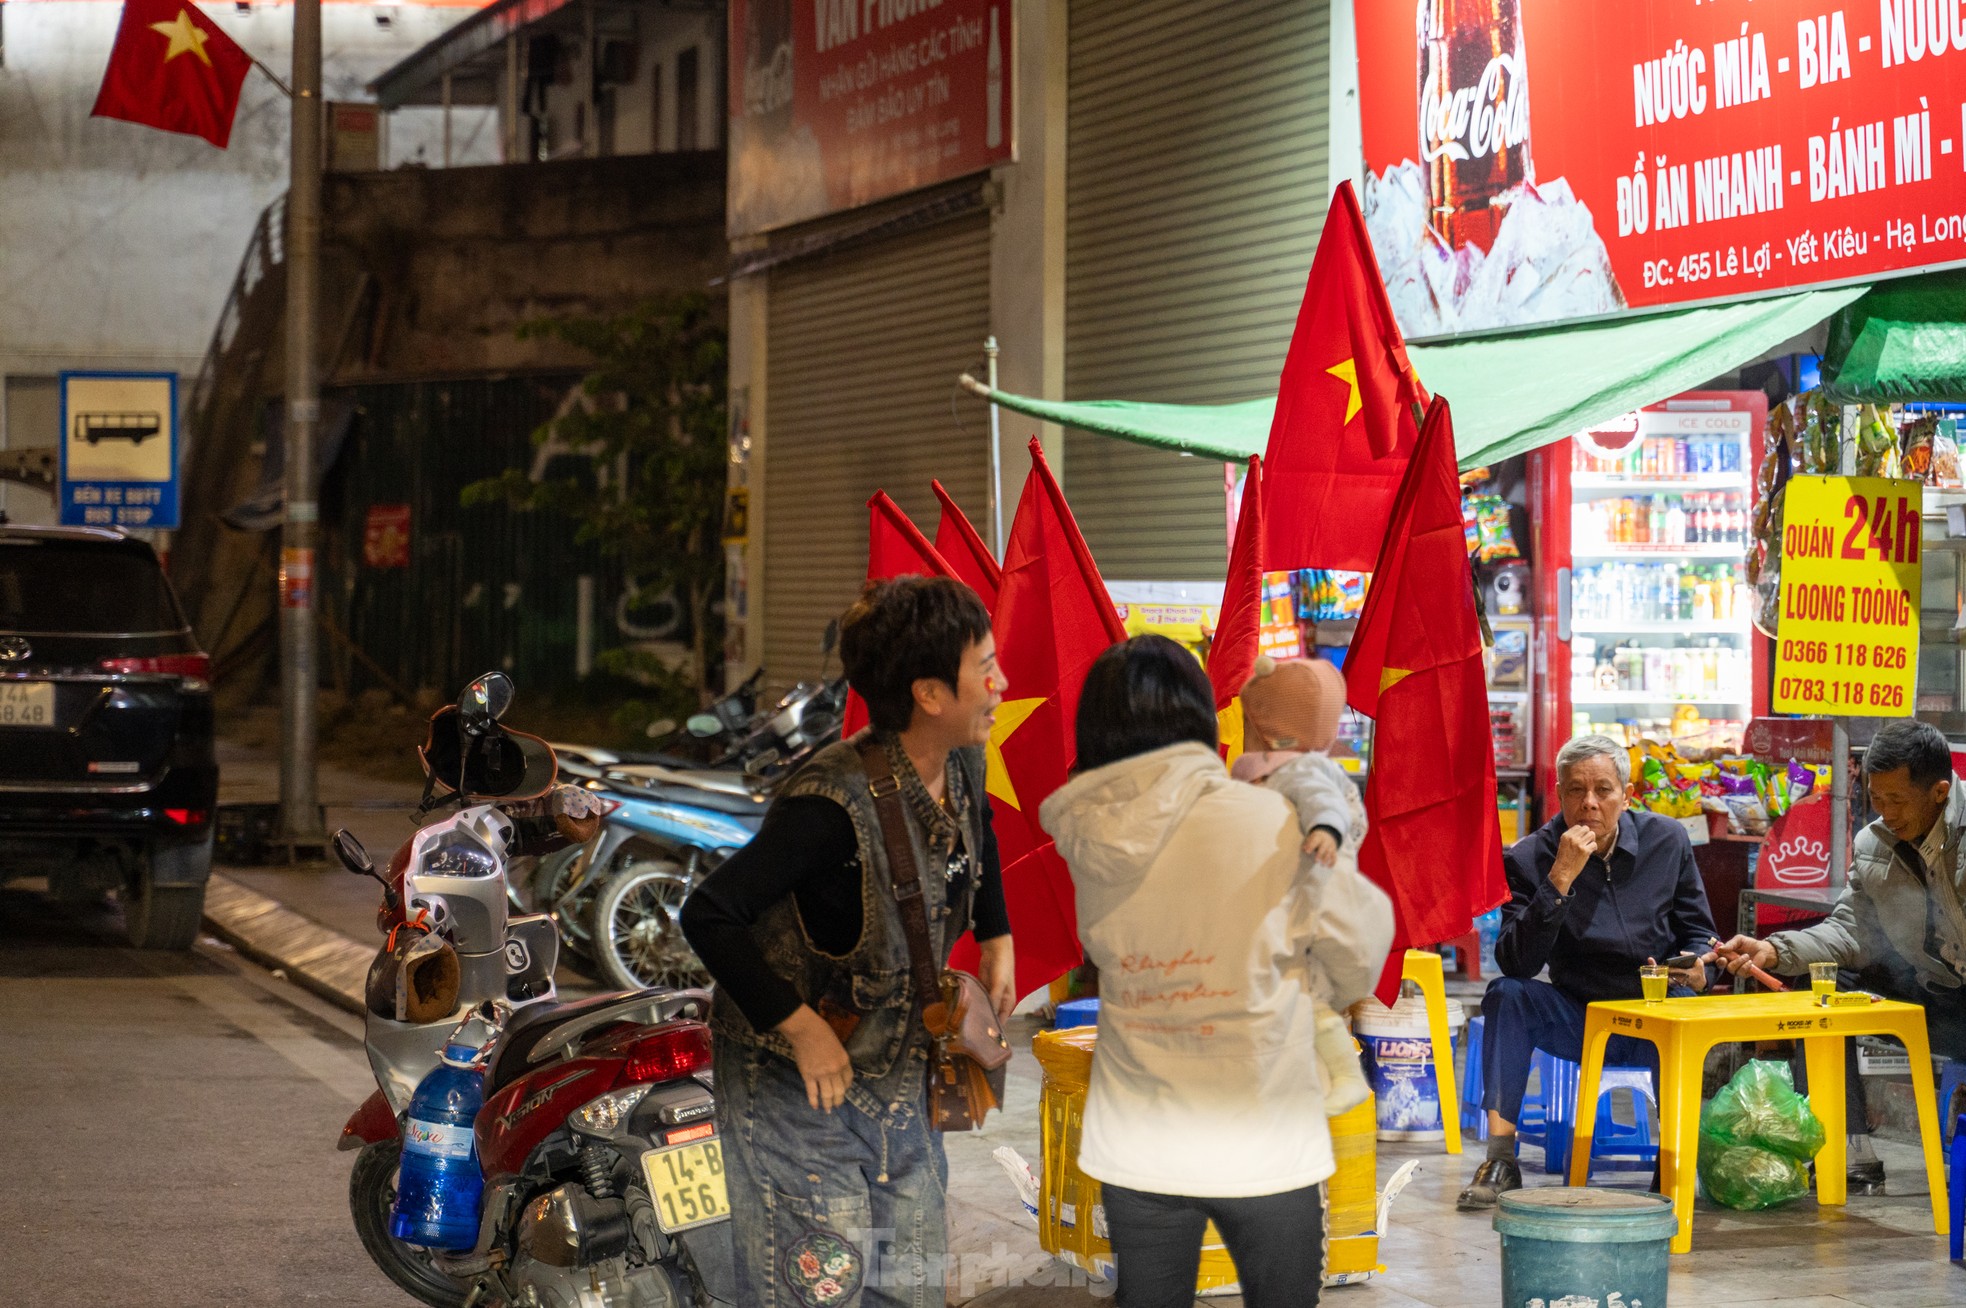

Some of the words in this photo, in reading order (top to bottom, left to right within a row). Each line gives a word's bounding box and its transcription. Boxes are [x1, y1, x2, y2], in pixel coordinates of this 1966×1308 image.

[1633, 38, 1707, 128] NƯỚC
[1713, 21, 1771, 110] MÍA
[1797, 10, 1851, 90] BIA
[1616, 150, 1649, 238] ĐỒ
[1655, 154, 1690, 231] ĂN
[1694, 144, 1784, 224] NHANH
[1808, 116, 1887, 203] BÁNH
[1893, 96, 1932, 186] MÌ
[1643, 258, 1674, 289] ĐC:
[1677, 251, 1712, 283] 455
[1715, 246, 1739, 278] Lê
[1742, 241, 1771, 279] Lợi
[1786, 229, 1819, 267] Yết
[1823, 226, 1868, 261] Kiêu
[1886, 218, 1917, 253] Hạ
[1921, 213, 1966, 244] Lon
[1678, 419, 1699, 429] ICE
[1704, 418, 1741, 429] COLD
[1786, 518, 1834, 560] QUÁN
[1841, 494, 1920, 564] 24h
[1786, 583, 1846, 622] LOONG
[1852, 578, 1910, 627] TOÒNG
[1782, 639, 1828, 664] 0366
[1834, 642, 1867, 667] 118
[1873, 645, 1906, 669] 626
[1780, 677, 1825, 702] 0783
[1832, 681, 1864, 705] 118
[1869, 683, 1904, 707] 626
